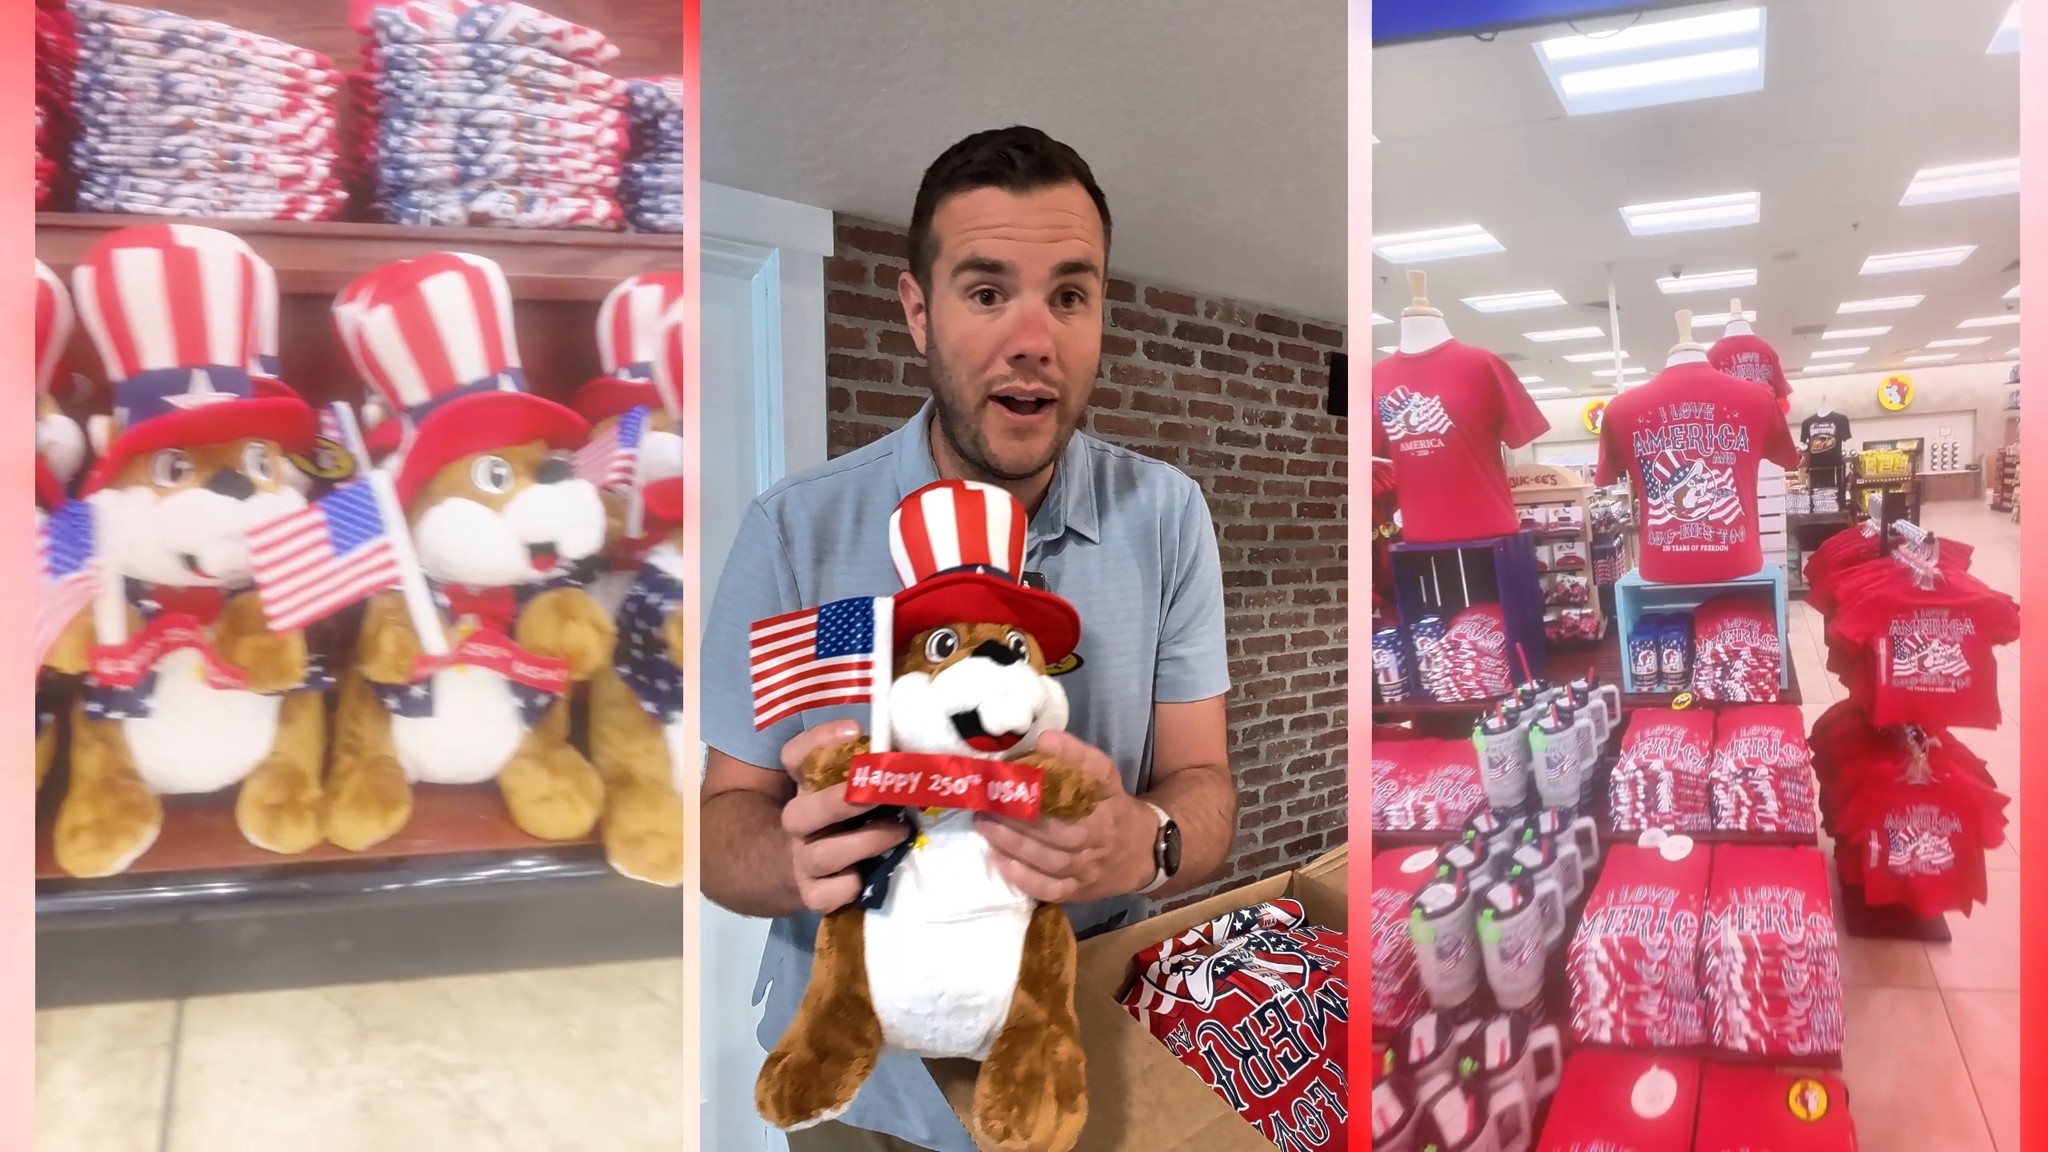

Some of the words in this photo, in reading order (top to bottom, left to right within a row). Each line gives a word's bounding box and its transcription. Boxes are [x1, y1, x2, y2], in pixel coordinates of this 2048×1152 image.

[1659, 406, 1668, 423] I
[1669, 401, 1715, 421] LOVE
[1400, 438, 1445, 451] AMERICA
[1633, 423, 1750, 458] AMERICA
[1712, 452, 1737, 465] AND
[987, 780, 1039, 804] USA!
[1270, 981, 1290, 993] YM
[1164, 1018, 1196, 1058] AN
[1192, 984, 1348, 1112] MERI
[1256, 1075, 1348, 1152] LOV
